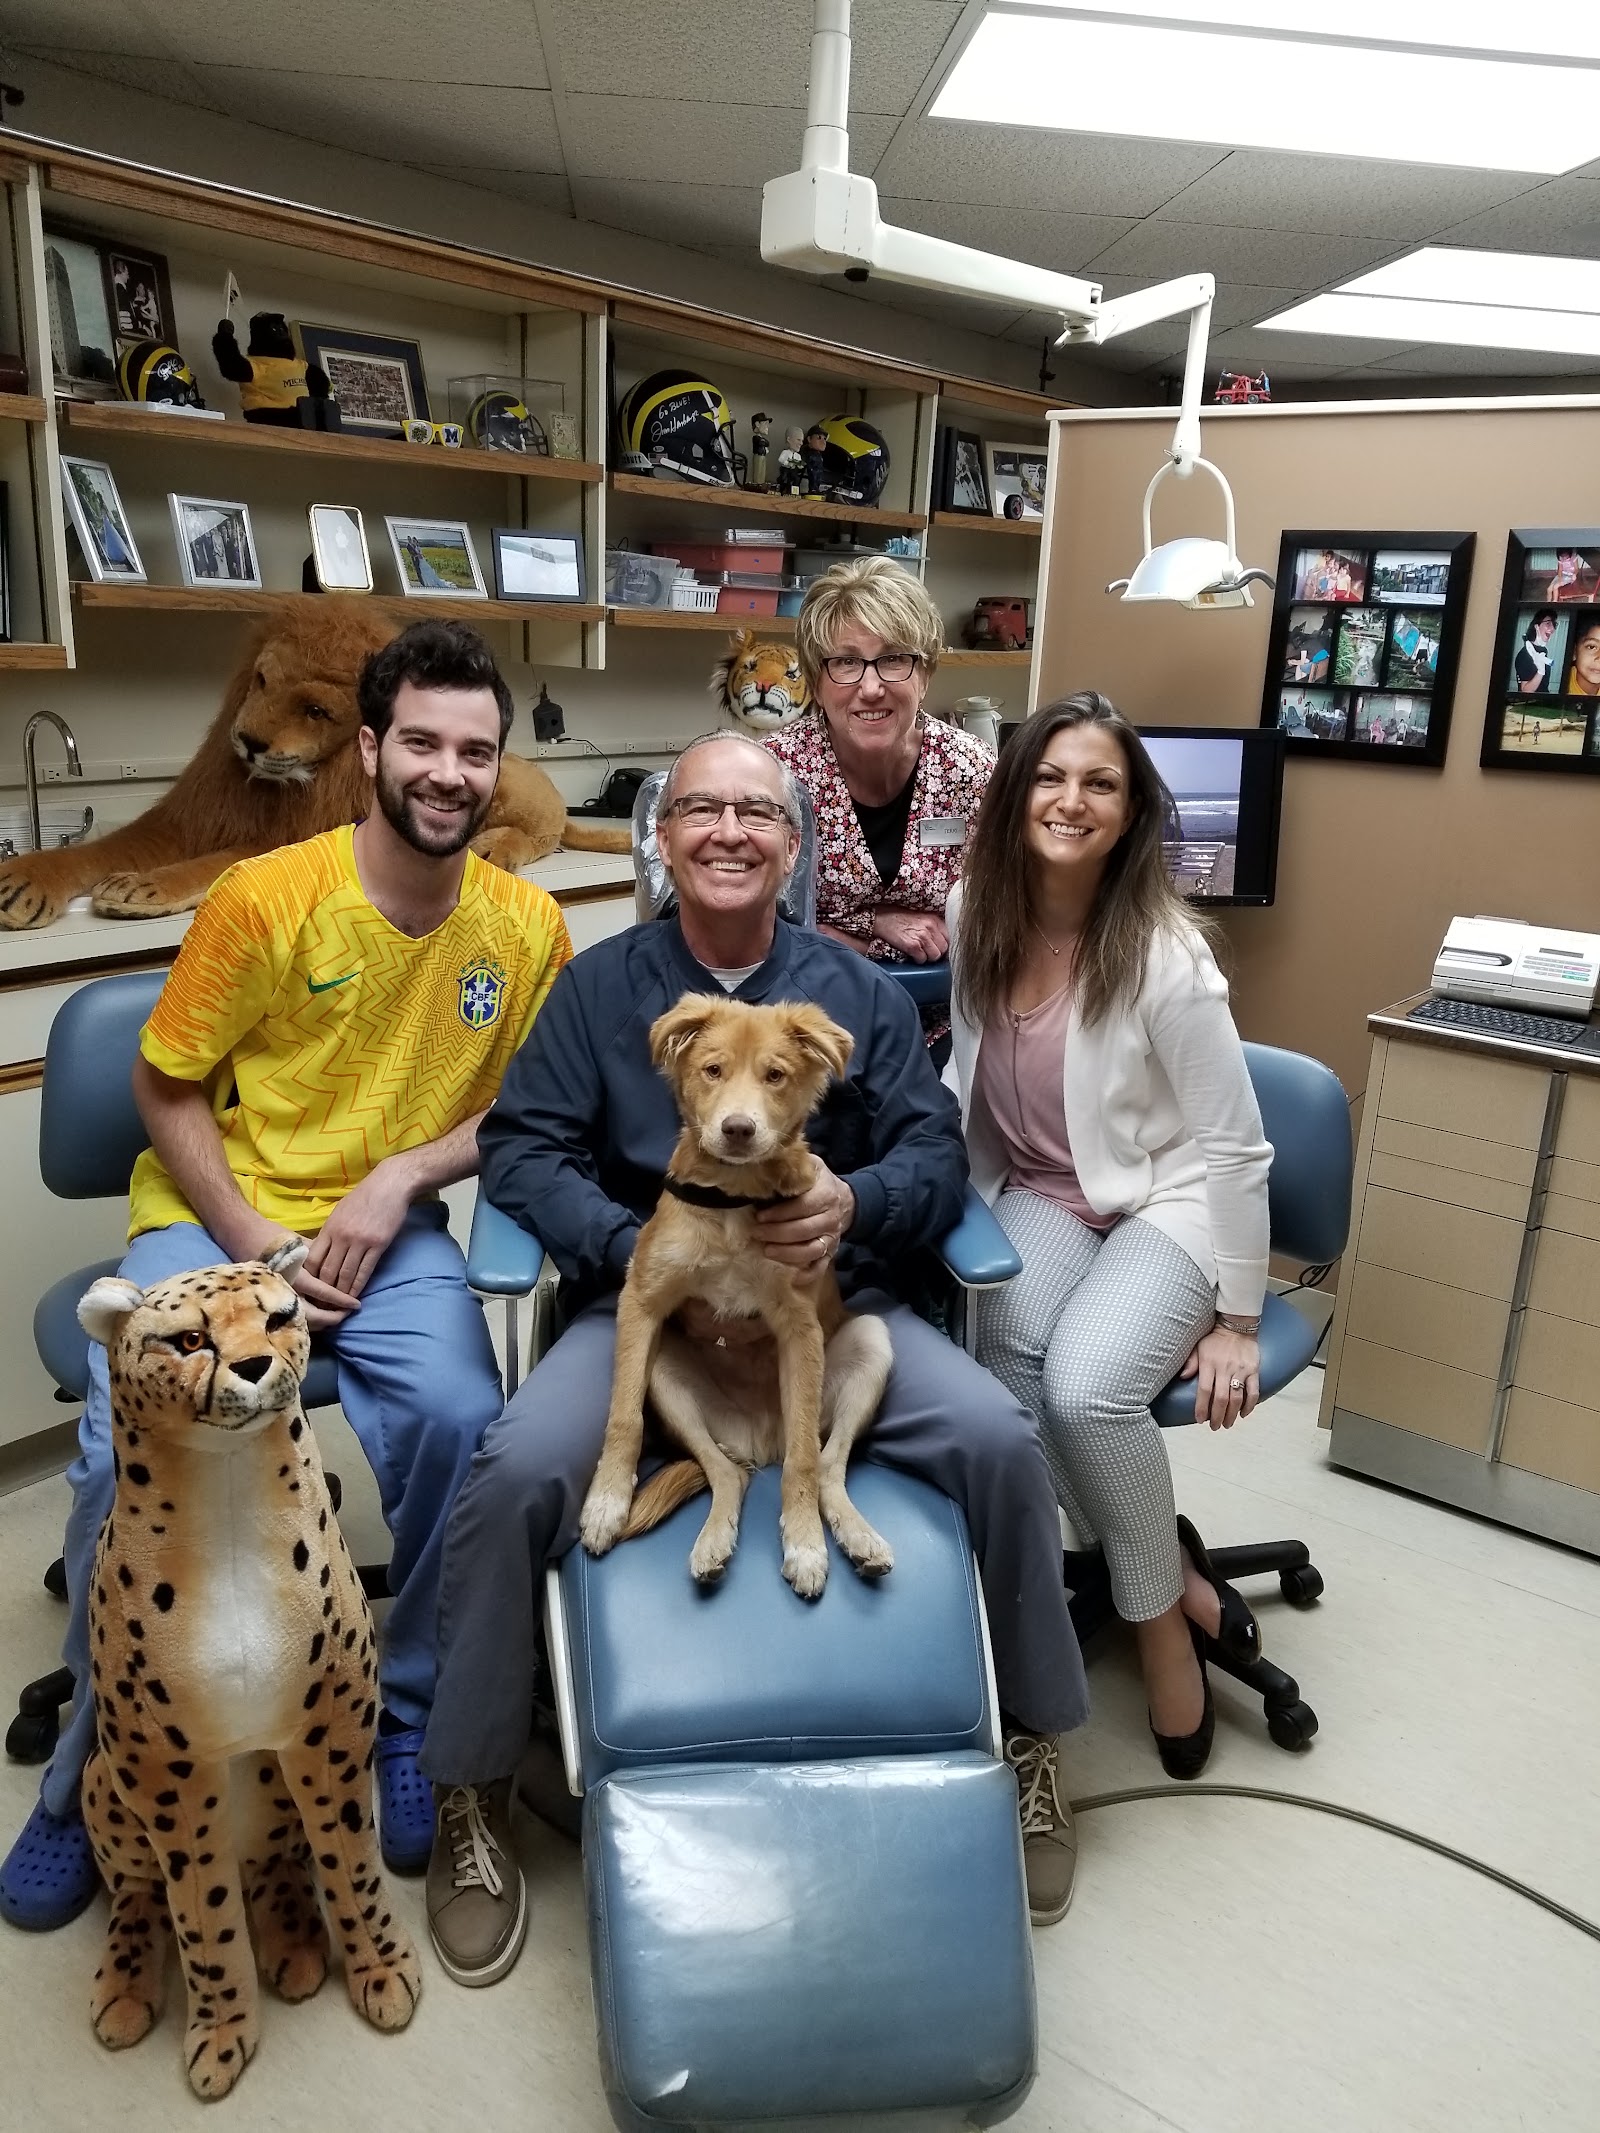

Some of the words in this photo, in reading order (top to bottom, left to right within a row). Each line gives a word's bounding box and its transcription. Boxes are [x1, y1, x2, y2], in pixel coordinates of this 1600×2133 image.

[668, 395, 691, 412] BLUE!
[445, 428, 458, 443] M
[471, 992, 490, 1001] CBF
